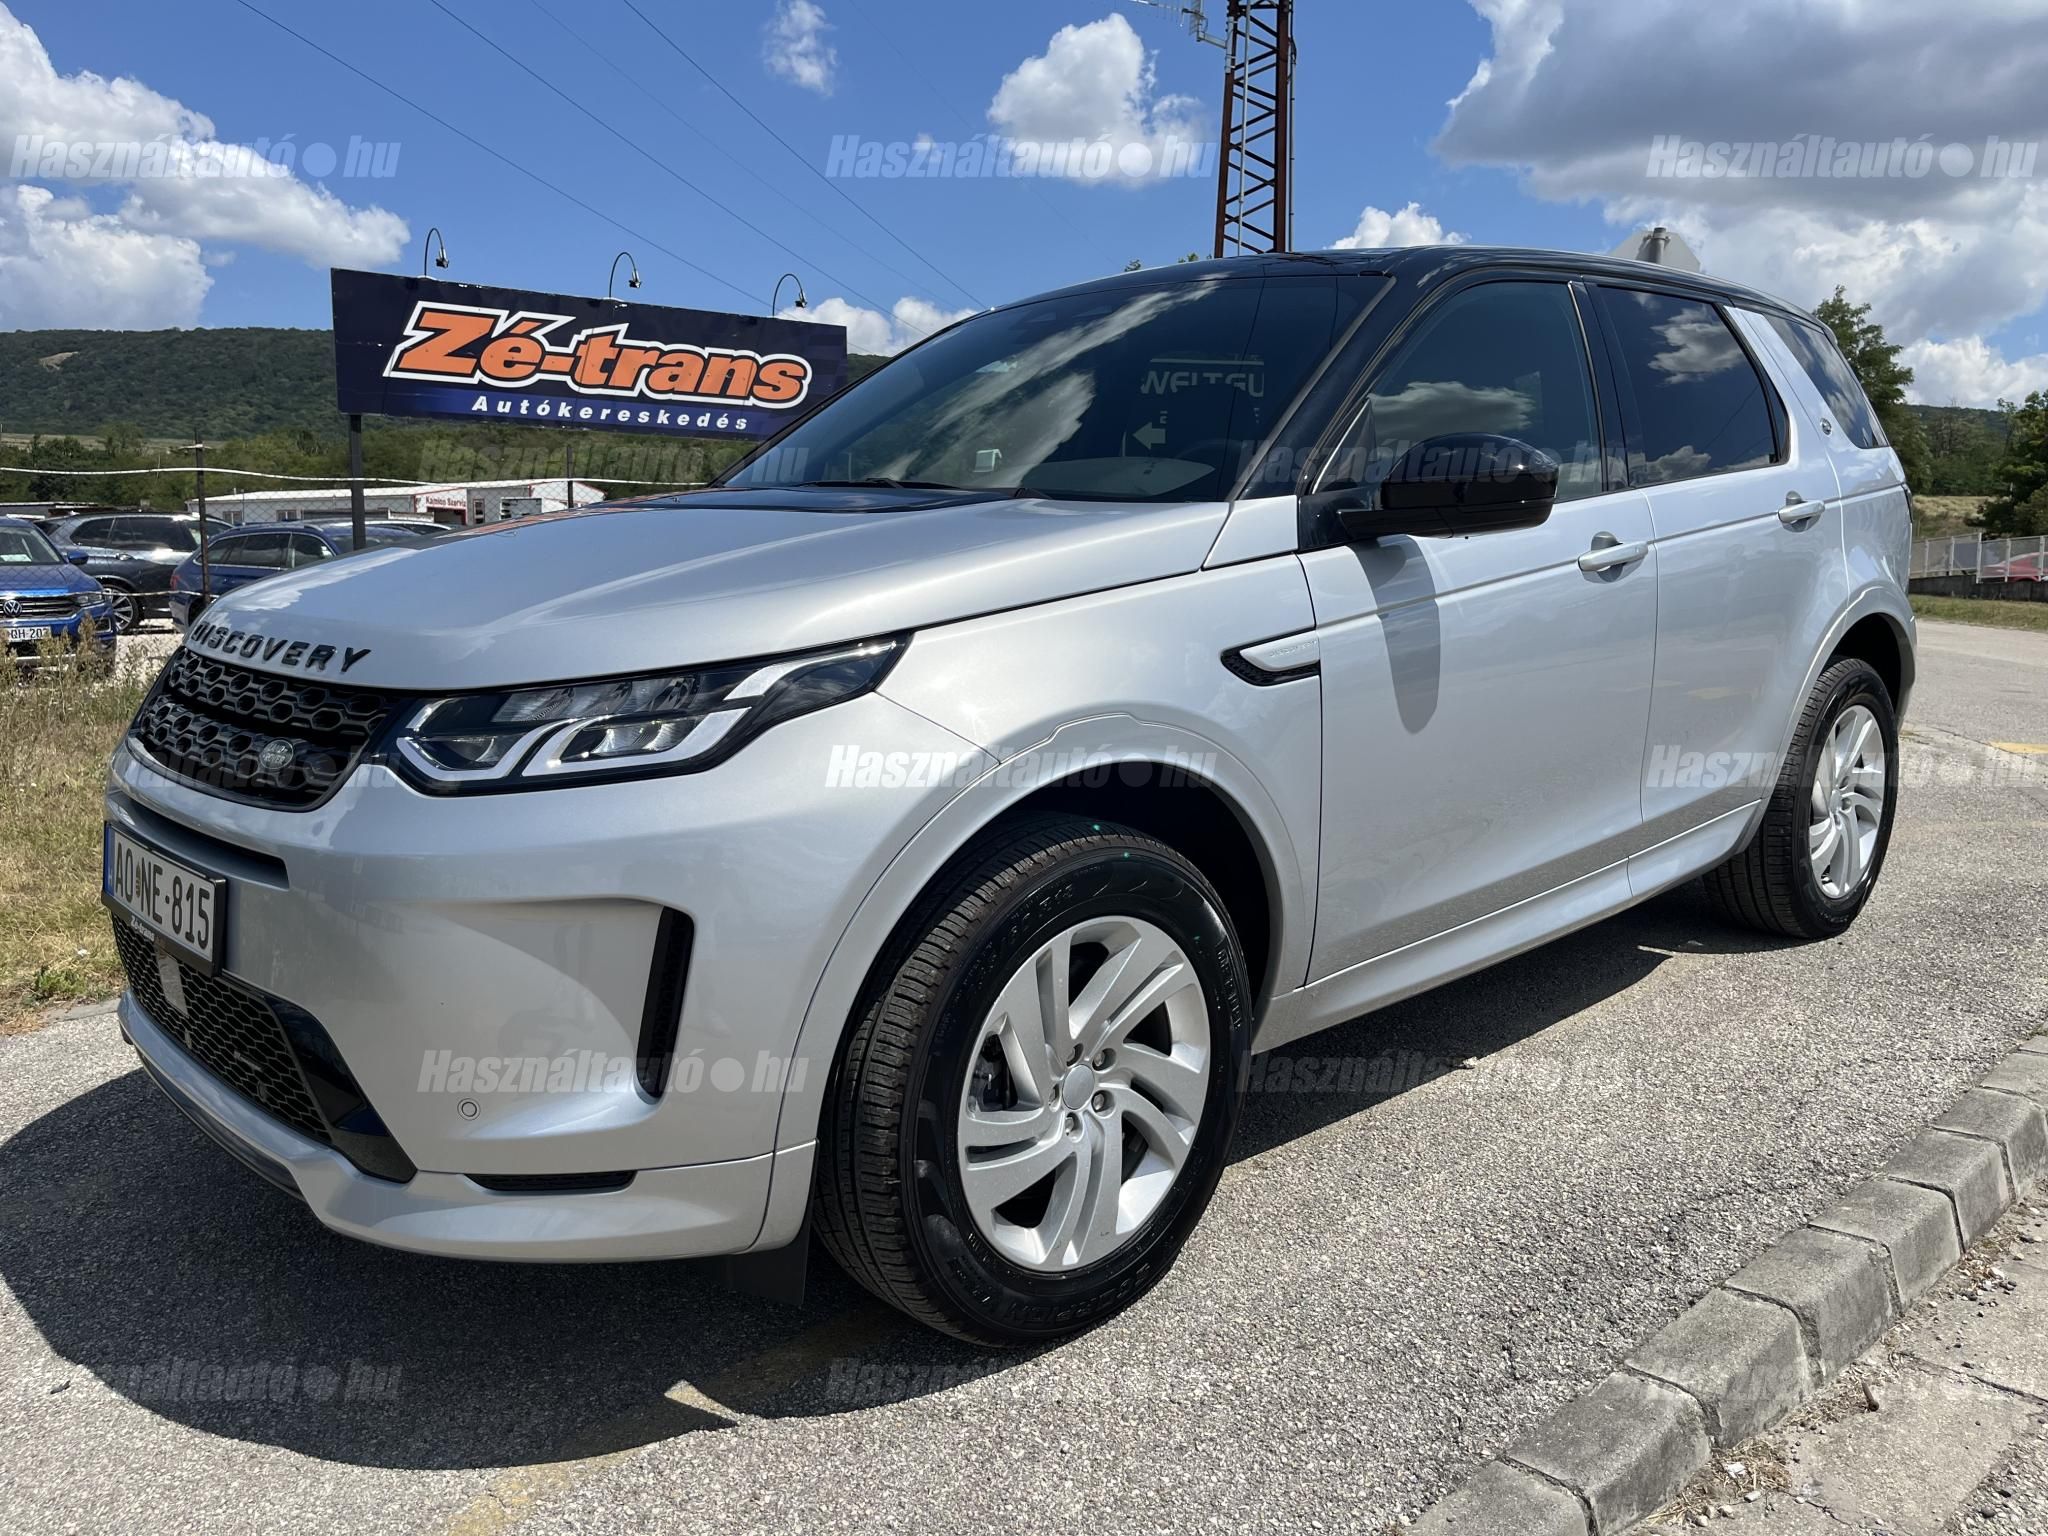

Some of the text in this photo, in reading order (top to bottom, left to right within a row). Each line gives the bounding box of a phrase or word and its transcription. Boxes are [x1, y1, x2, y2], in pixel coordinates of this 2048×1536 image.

[392, 307, 809, 404] Zé-trans
[472, 395, 748, 430] Autókereskedés
[191, 621, 371, 673] DISCOVERY
